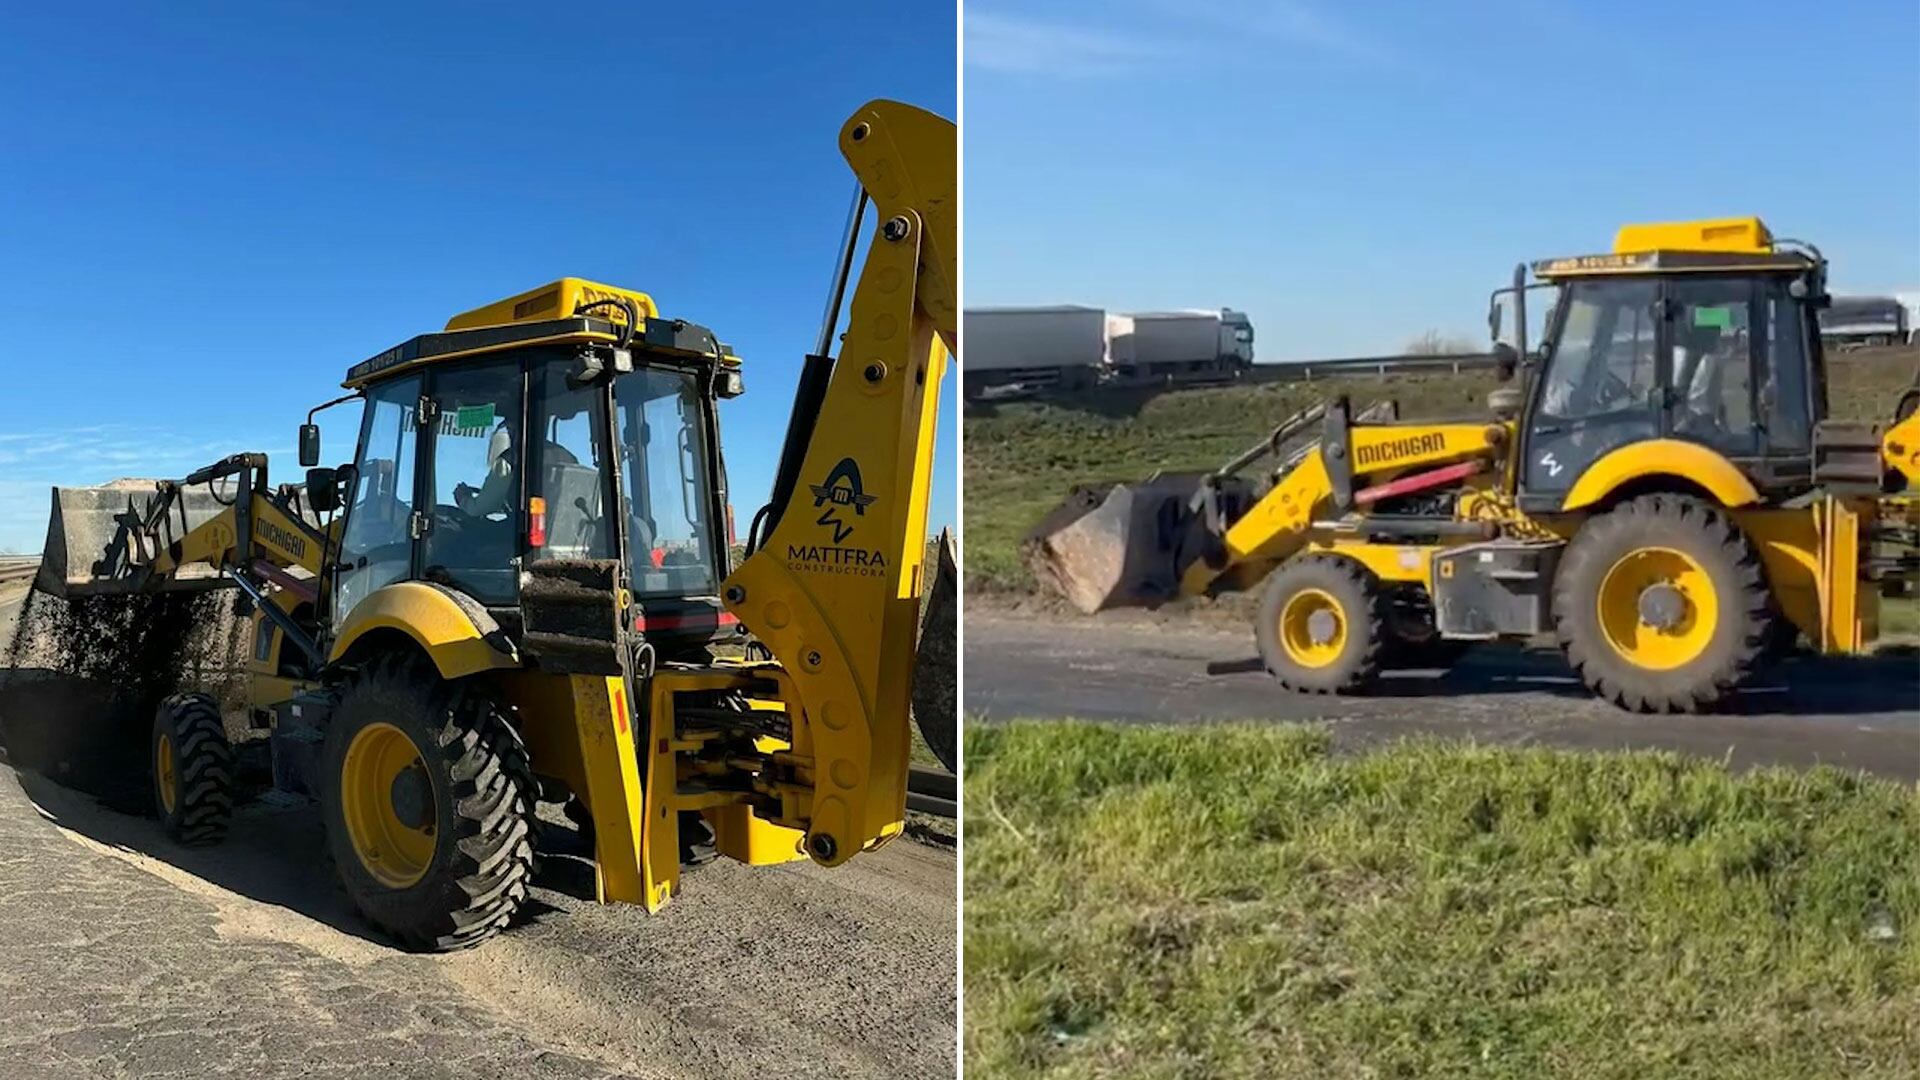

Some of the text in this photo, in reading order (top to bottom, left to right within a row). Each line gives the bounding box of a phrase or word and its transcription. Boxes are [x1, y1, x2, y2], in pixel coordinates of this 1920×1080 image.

[1356, 432, 1446, 466] MICHIGAN
[255, 517, 305, 560] MICHIGAN
[786, 543, 886, 568] MATTFRA
[786, 562, 887, 577] CONSTRUCTORA
